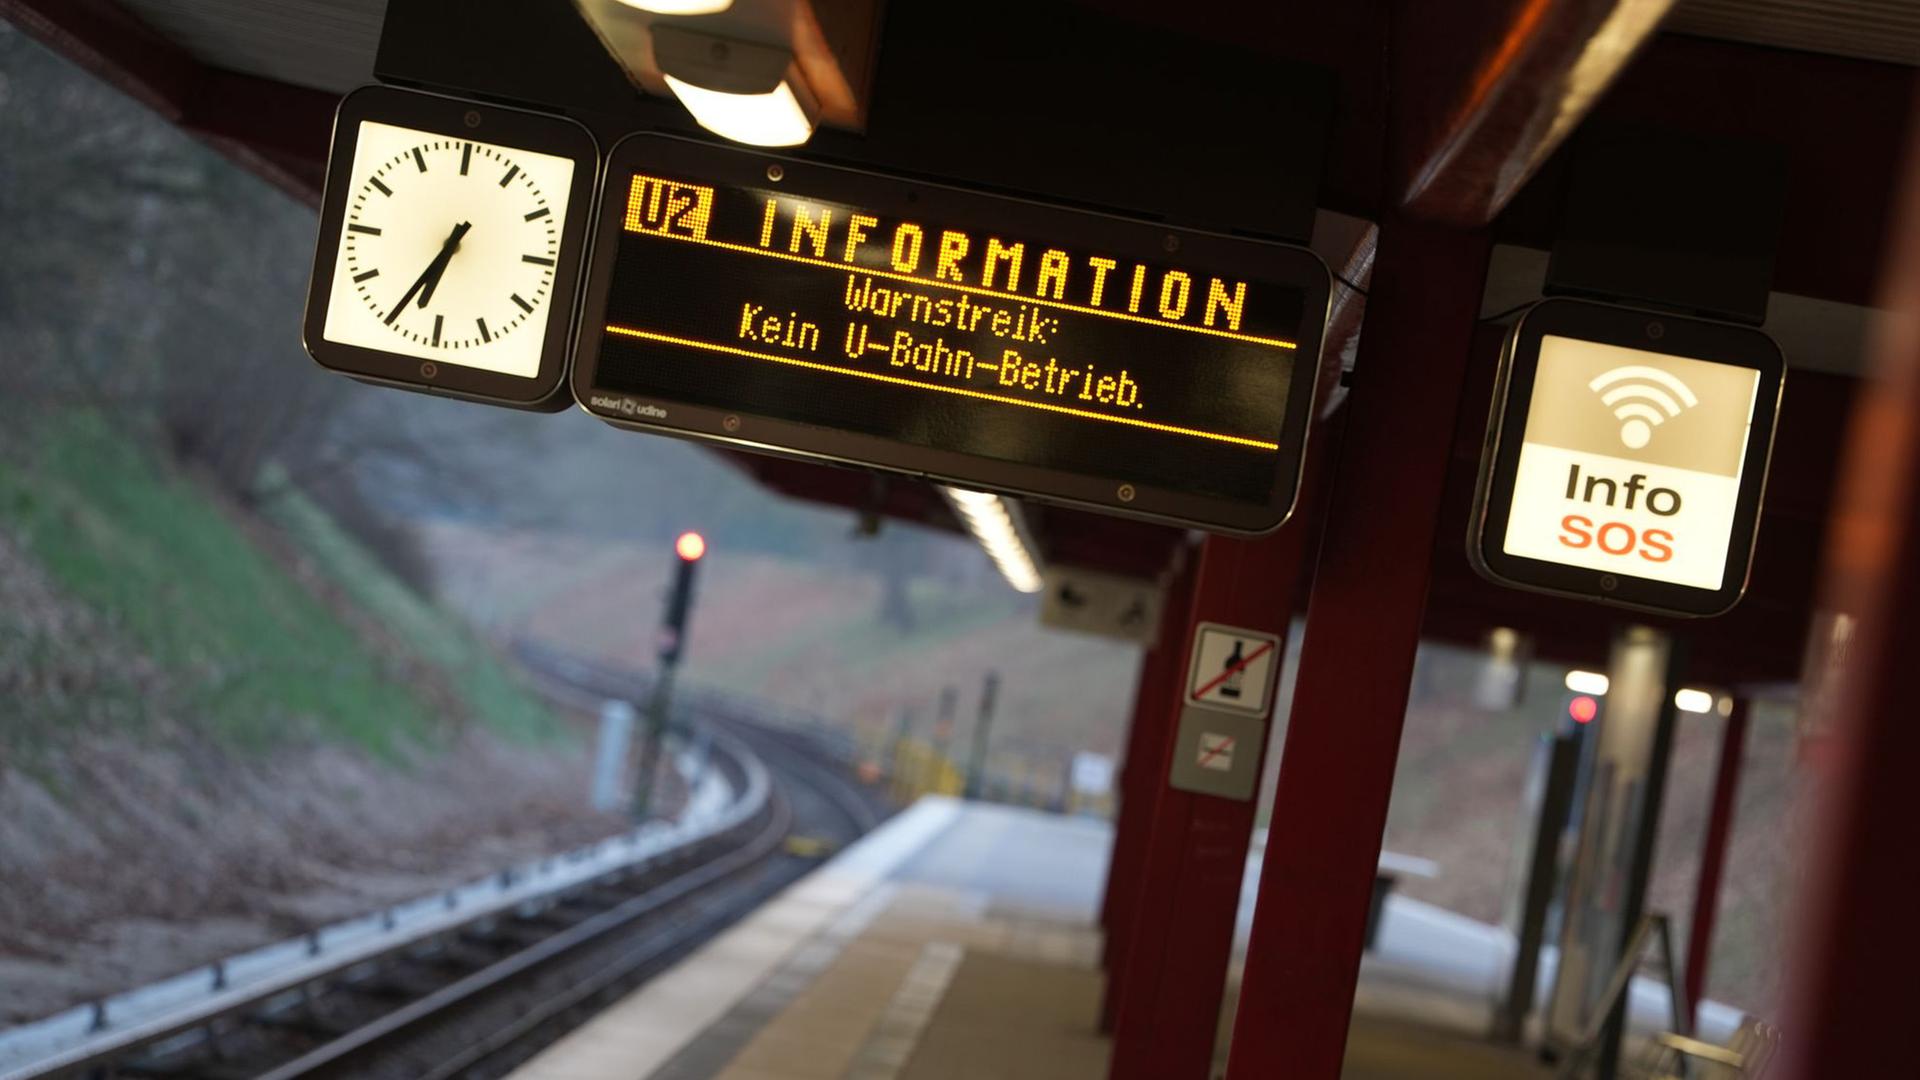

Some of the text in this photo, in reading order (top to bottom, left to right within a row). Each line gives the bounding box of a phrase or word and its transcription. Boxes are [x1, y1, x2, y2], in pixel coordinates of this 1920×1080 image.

[638, 181, 1248, 331] U2 INFORMATION
[844, 273, 1059, 344] Warnstreik:
[738, 302, 1144, 409] Kein U-Bahn-Betrieb.
[637, 404, 667, 418] udine
[1564, 463, 1683, 517] Info
[1558, 514, 1675, 564] SOS
